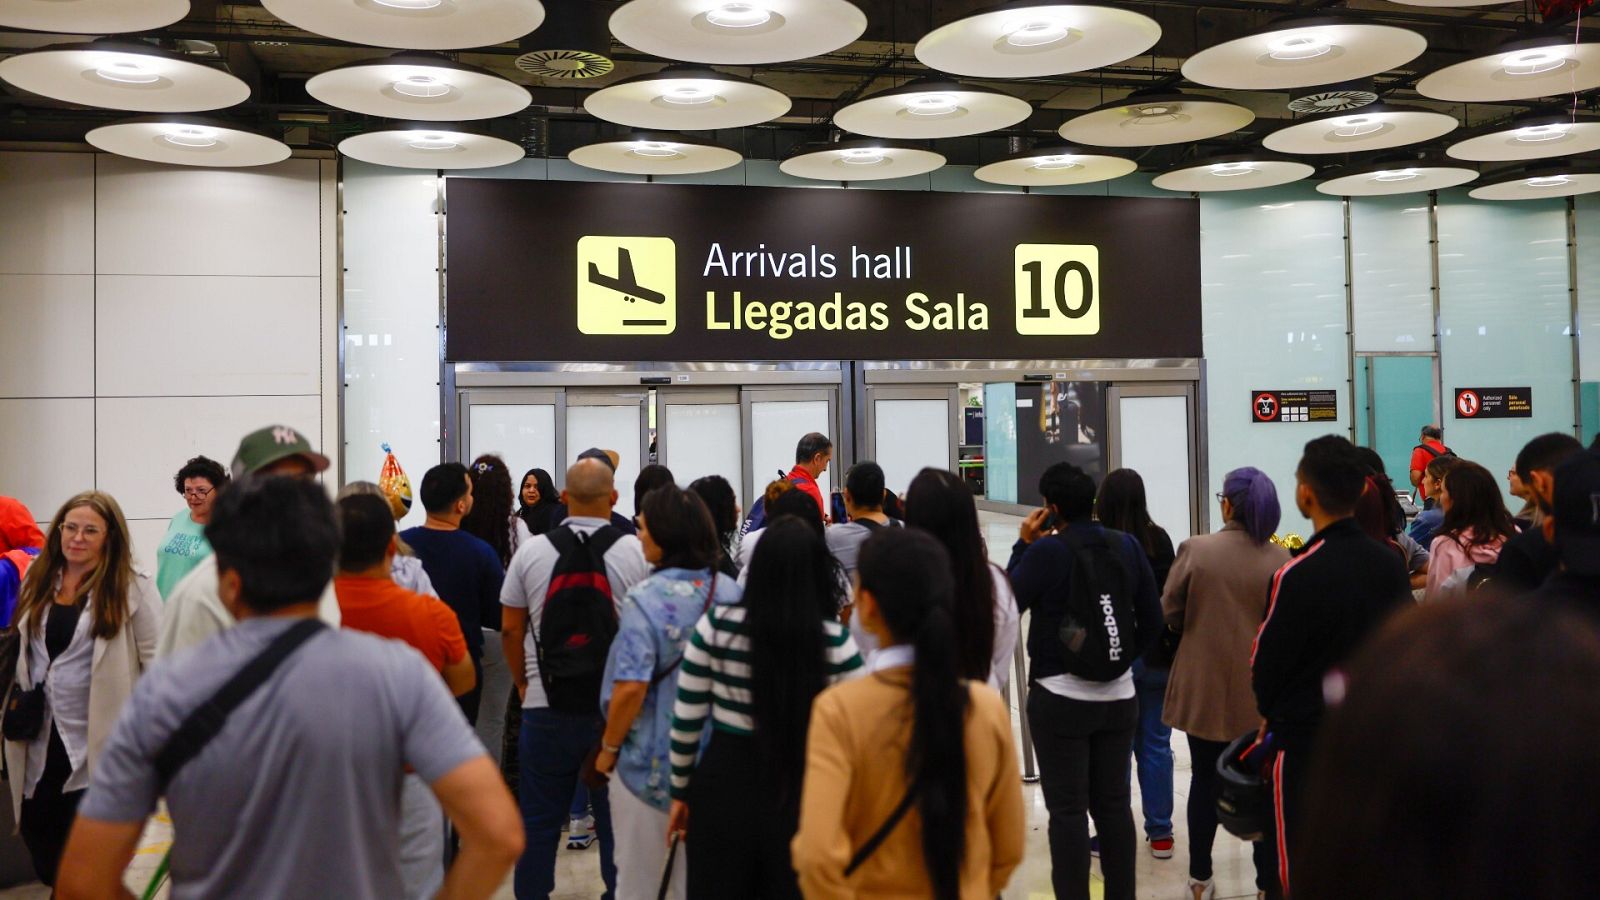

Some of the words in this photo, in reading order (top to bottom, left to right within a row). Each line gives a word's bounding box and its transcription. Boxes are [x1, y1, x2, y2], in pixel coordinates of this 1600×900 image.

[703, 243, 837, 279] Arrivals
[851, 245, 911, 279] hall
[1021, 260, 1094, 319] 10
[706, 291, 889, 340] Llegadas
[904, 292, 989, 331] Sala
[739, 519, 753, 540] UMA
[1099, 594, 1122, 661] Reebok
